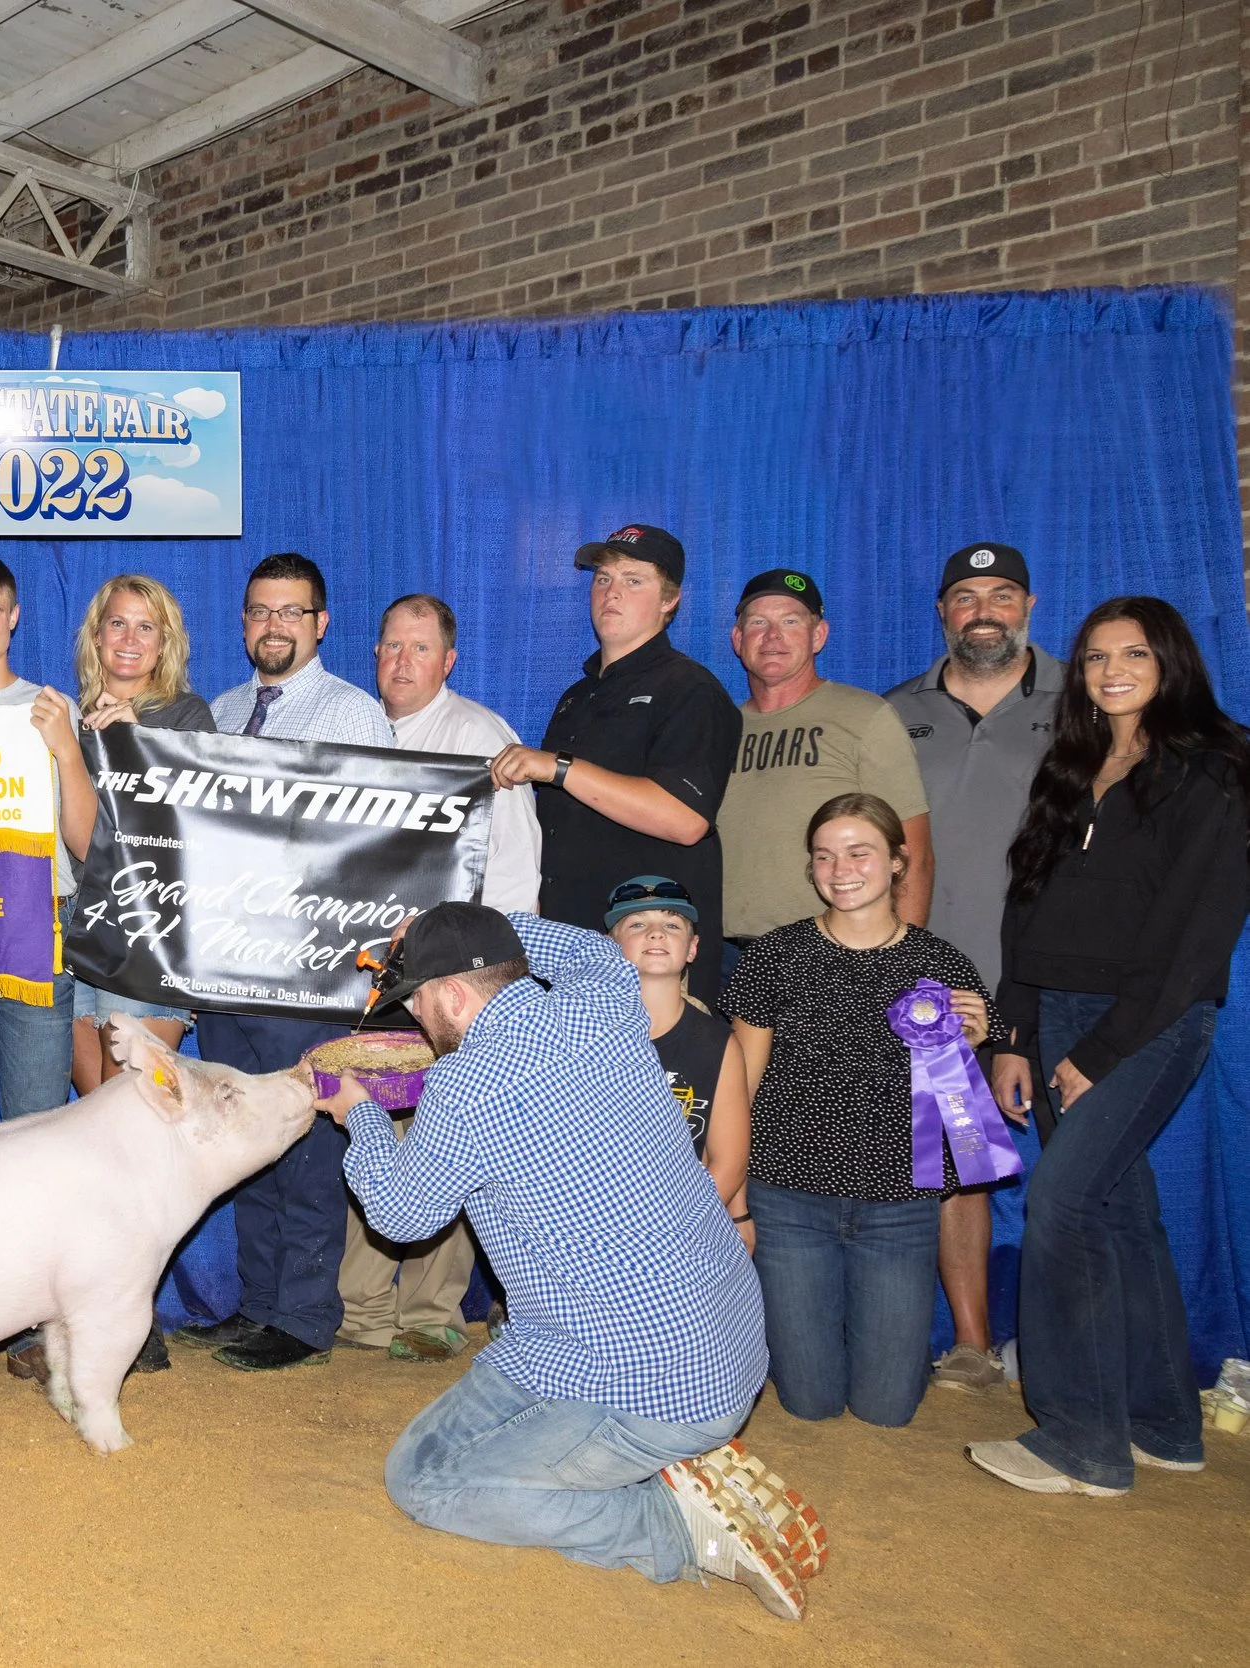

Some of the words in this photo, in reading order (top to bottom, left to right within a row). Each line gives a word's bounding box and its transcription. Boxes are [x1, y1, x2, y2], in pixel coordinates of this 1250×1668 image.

[102, 391, 192, 445] FAIR
[975, 552, 990, 566] SGI
[96, 770, 142, 793] THE
[114, 830, 184, 850] Congratulates
[110, 860, 250, 913] Grand
[83, 900, 182, 953] 4-H
[190, 917, 357, 973] Market
[160, 974, 190, 991] 2022
[191, 980, 218, 993] Iowa
[218, 981, 249, 997] State
[249, 985, 271, 999] Fair
[277, 988, 298, 1002] Des
[299, 990, 343, 1008] Moines,
[343, 995, 356, 1009] IA
